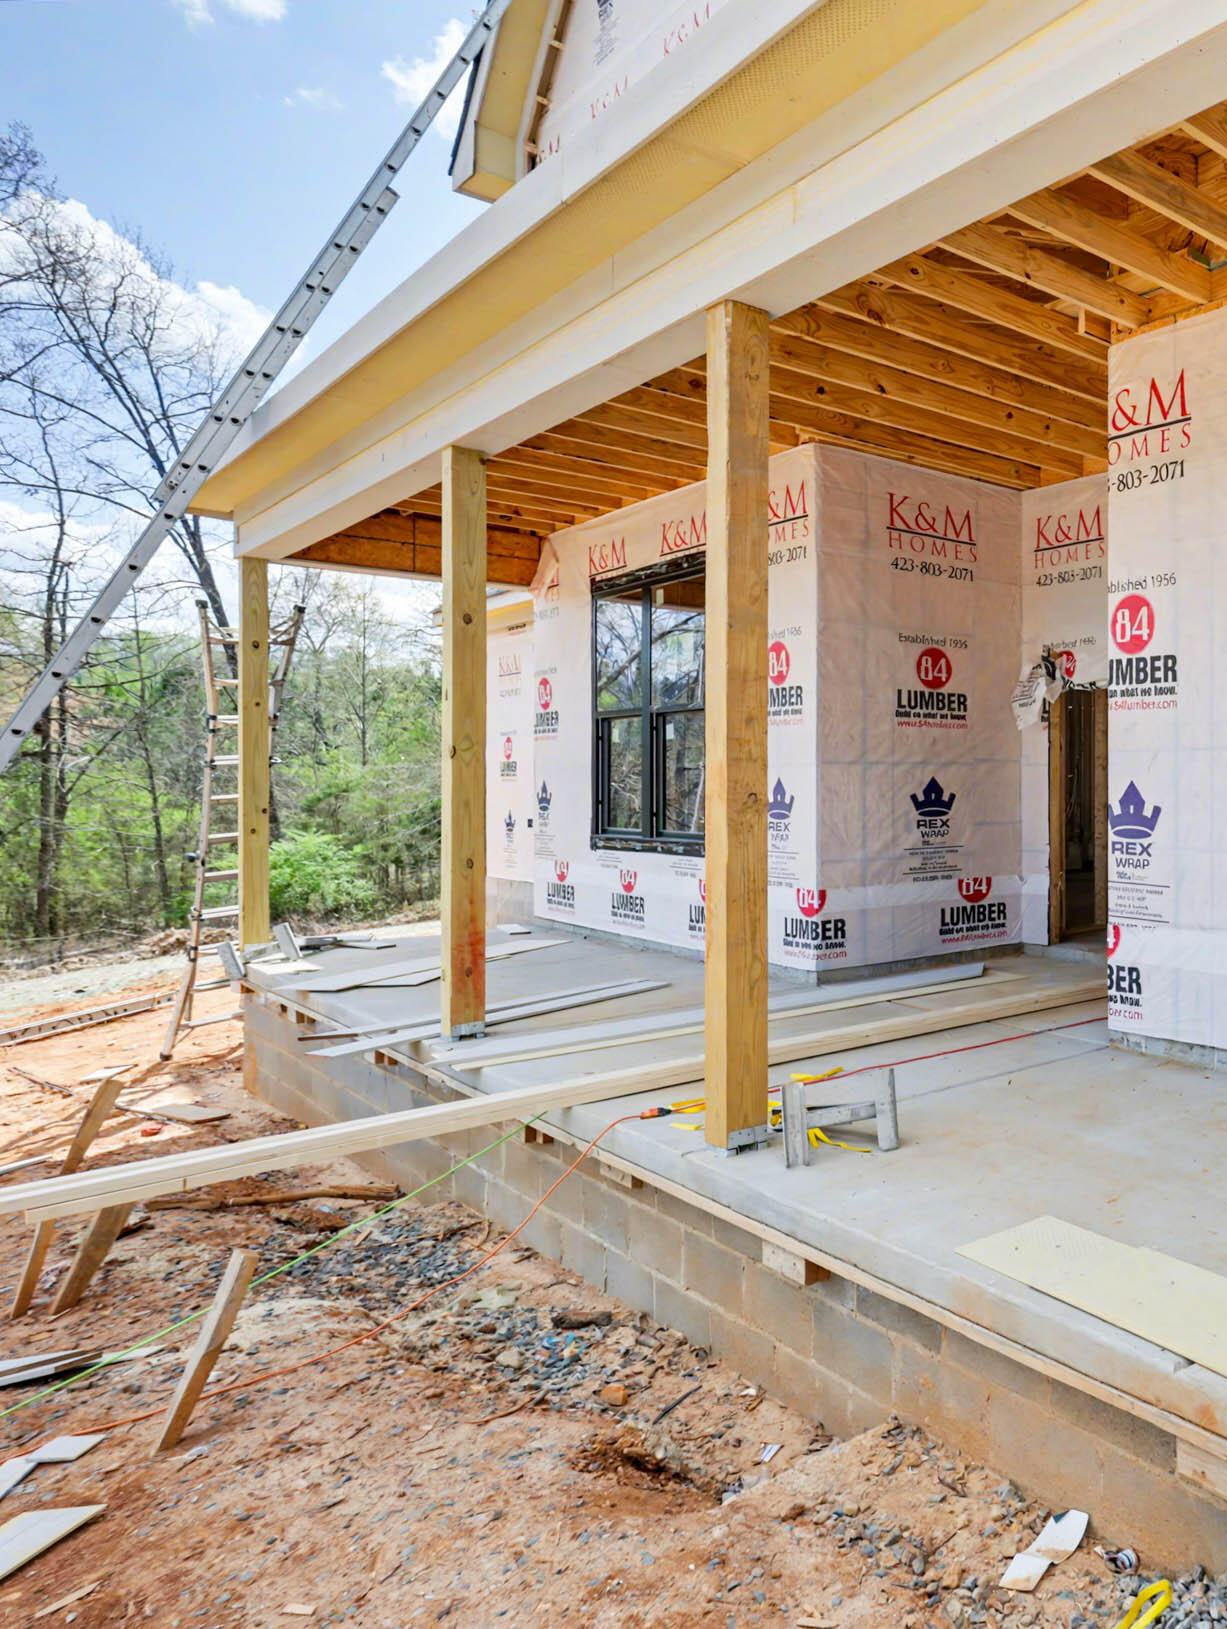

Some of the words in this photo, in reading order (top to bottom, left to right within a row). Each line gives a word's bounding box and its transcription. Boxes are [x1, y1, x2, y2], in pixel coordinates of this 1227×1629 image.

[888, 492, 976, 542] K&M
[1036, 504, 1103, 548] K&M
[660, 512, 707, 553] K&M
[589, 536, 627, 575] K&M
[888, 532, 977, 563] HOMES
[1034, 542, 1104, 568] HOMES
[891, 557, 974, 582] 423-803-2071
[1036, 566, 1102, 587] 423-803-2071
[1151, 573, 1177, 590] 1956
[1115, 604, 1150, 644] 84
[769, 650, 788, 676] 84
[921, 656, 948, 682] 84
[897, 689, 968, 712] LUMBER
[916, 818, 950, 829] REX
[921, 830, 949, 839] WRAP
[1112, 841, 1152, 857] REX
[1115, 858, 1150, 869] WRAP
[941, 902, 1007, 927] LUMBER
[784, 917, 847, 940] LUMBER
